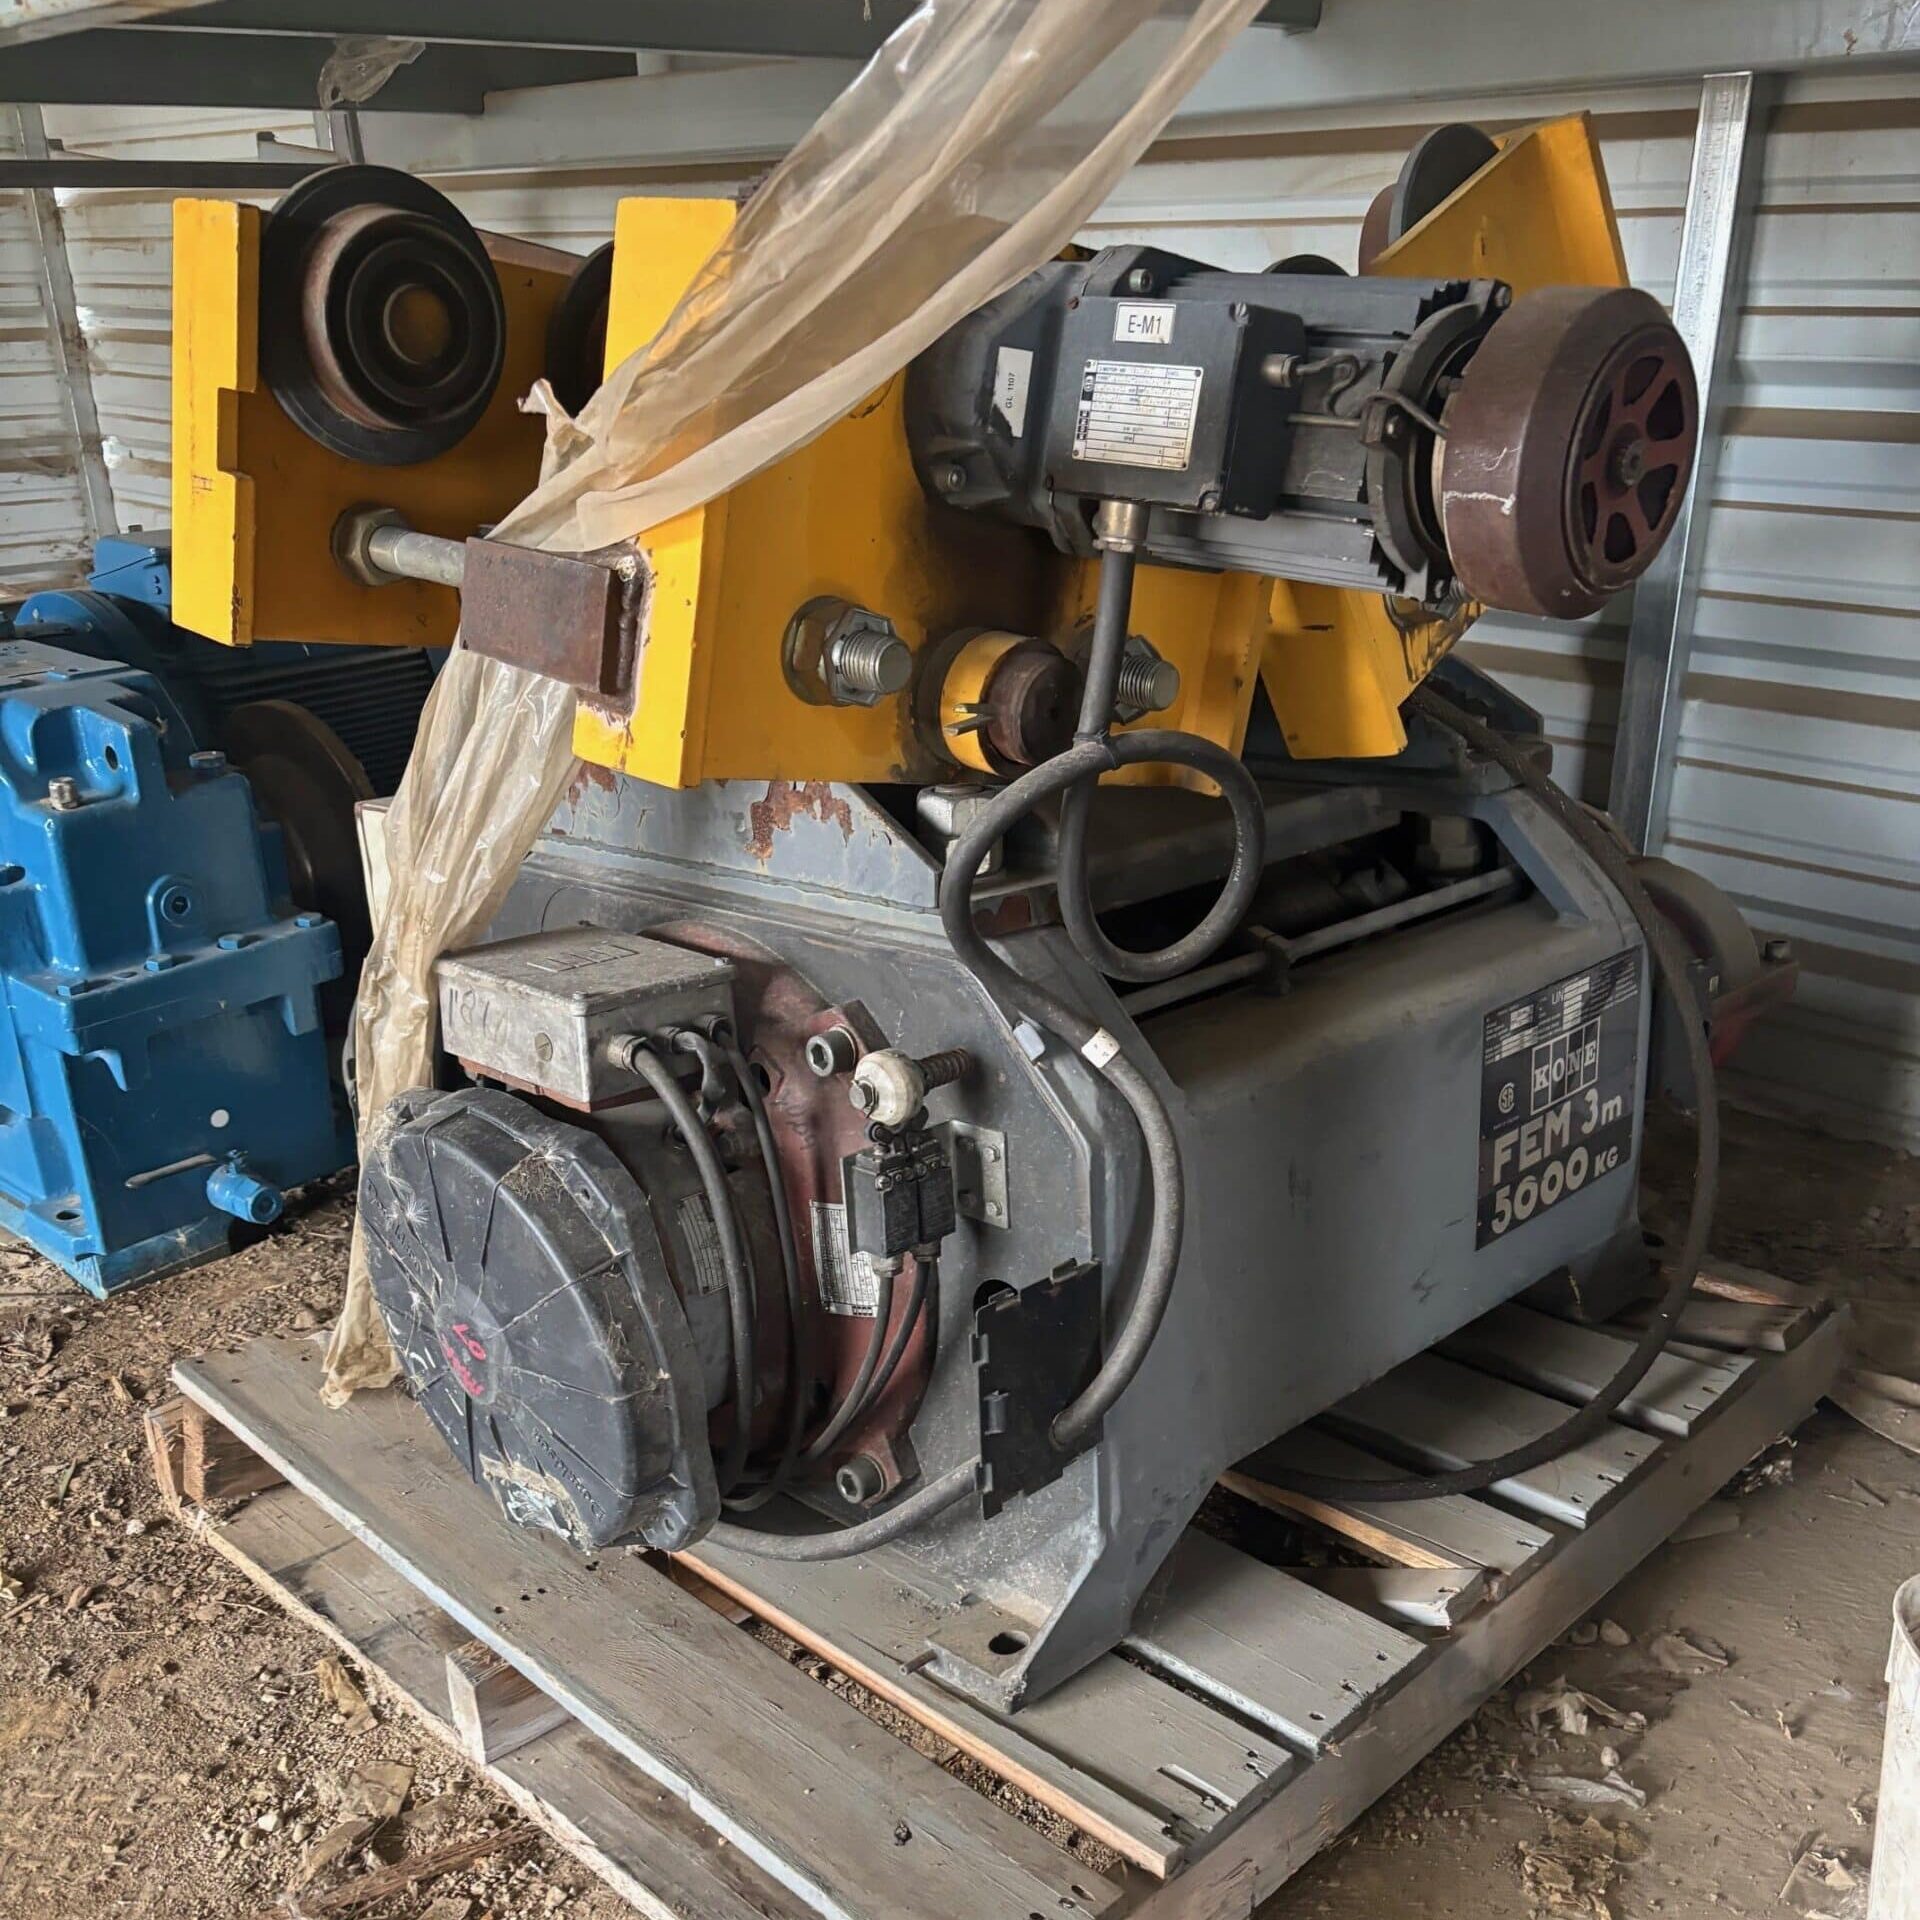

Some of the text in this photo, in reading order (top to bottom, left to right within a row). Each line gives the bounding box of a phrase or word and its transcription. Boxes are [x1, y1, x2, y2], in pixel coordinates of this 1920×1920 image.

[1127, 314, 1163, 336] E-M1
[1007, 372, 1016, 391] 1107
[1534, 1040, 1597, 1092] KONE
[1492, 1100, 1572, 1187] FEM
[1490, 1145, 1619, 1234] 5000 KG
